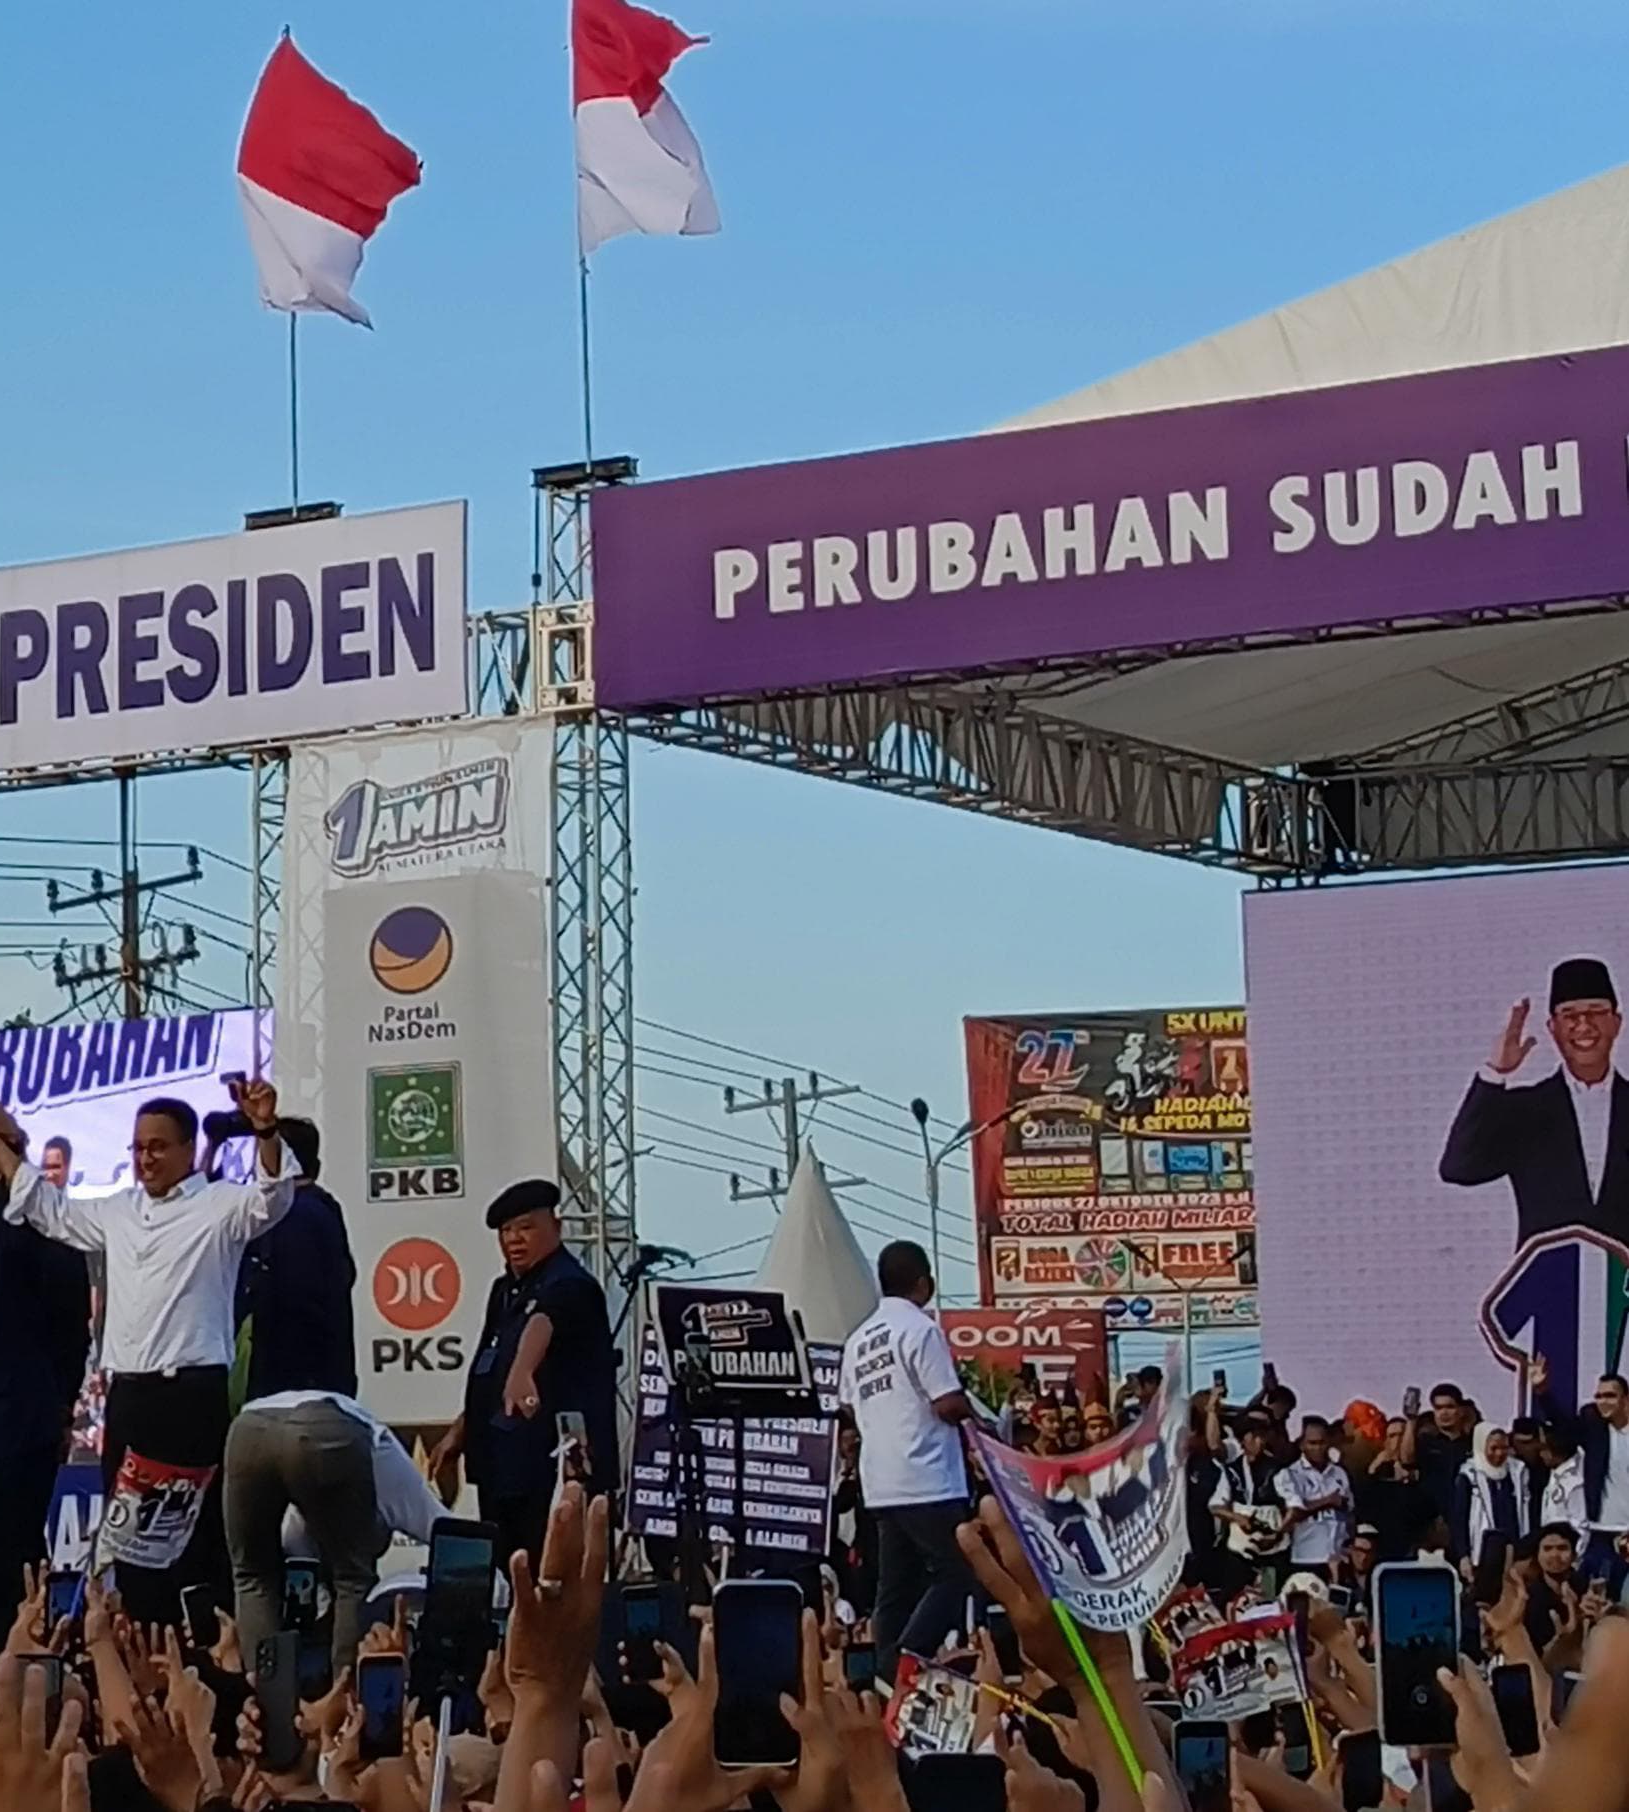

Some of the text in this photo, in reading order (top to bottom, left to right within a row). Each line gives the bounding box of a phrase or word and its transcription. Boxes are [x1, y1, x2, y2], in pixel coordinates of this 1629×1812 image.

[714, 440, 1583, 619] PERUBAHAN SUDAH
[369, 776, 499, 850] AMIN
[384, 1001, 439, 1024] Partai
[368, 1022, 457, 1043] NasDem
[1217, 1112, 1251, 1128] MO
[371, 1168, 460, 1198] PKB
[1001, 1213, 1073, 1234] TOTAL
[371, 1335, 465, 1373] PKS
[673, 1350, 796, 1378] PUBAHAN
[1073, 1581, 1148, 1611] GERAK
